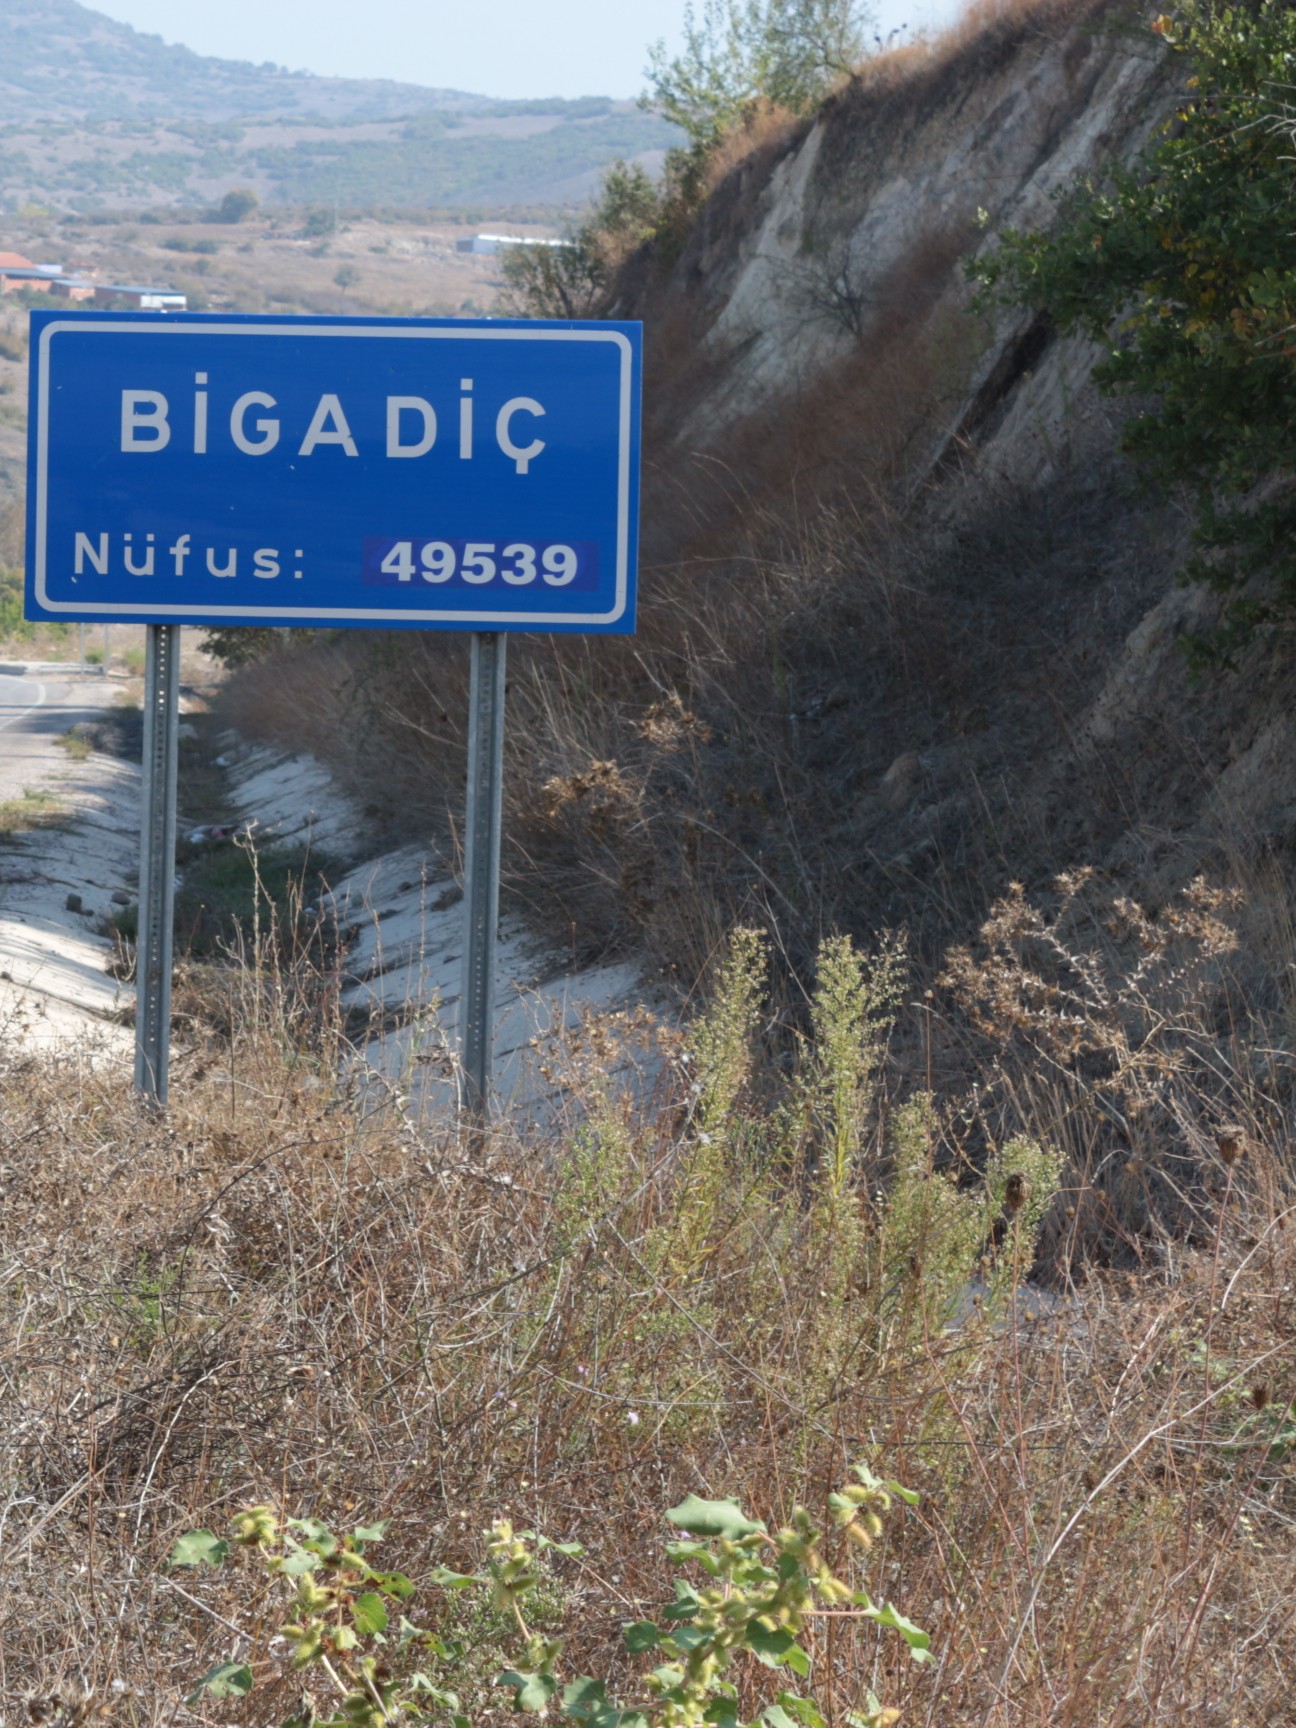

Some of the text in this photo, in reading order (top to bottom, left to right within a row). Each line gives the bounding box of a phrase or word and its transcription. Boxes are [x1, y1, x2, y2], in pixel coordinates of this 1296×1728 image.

[120, 371, 546, 475] BİGADİÇ
[73, 531, 580, 587] Nüfus: 49539
